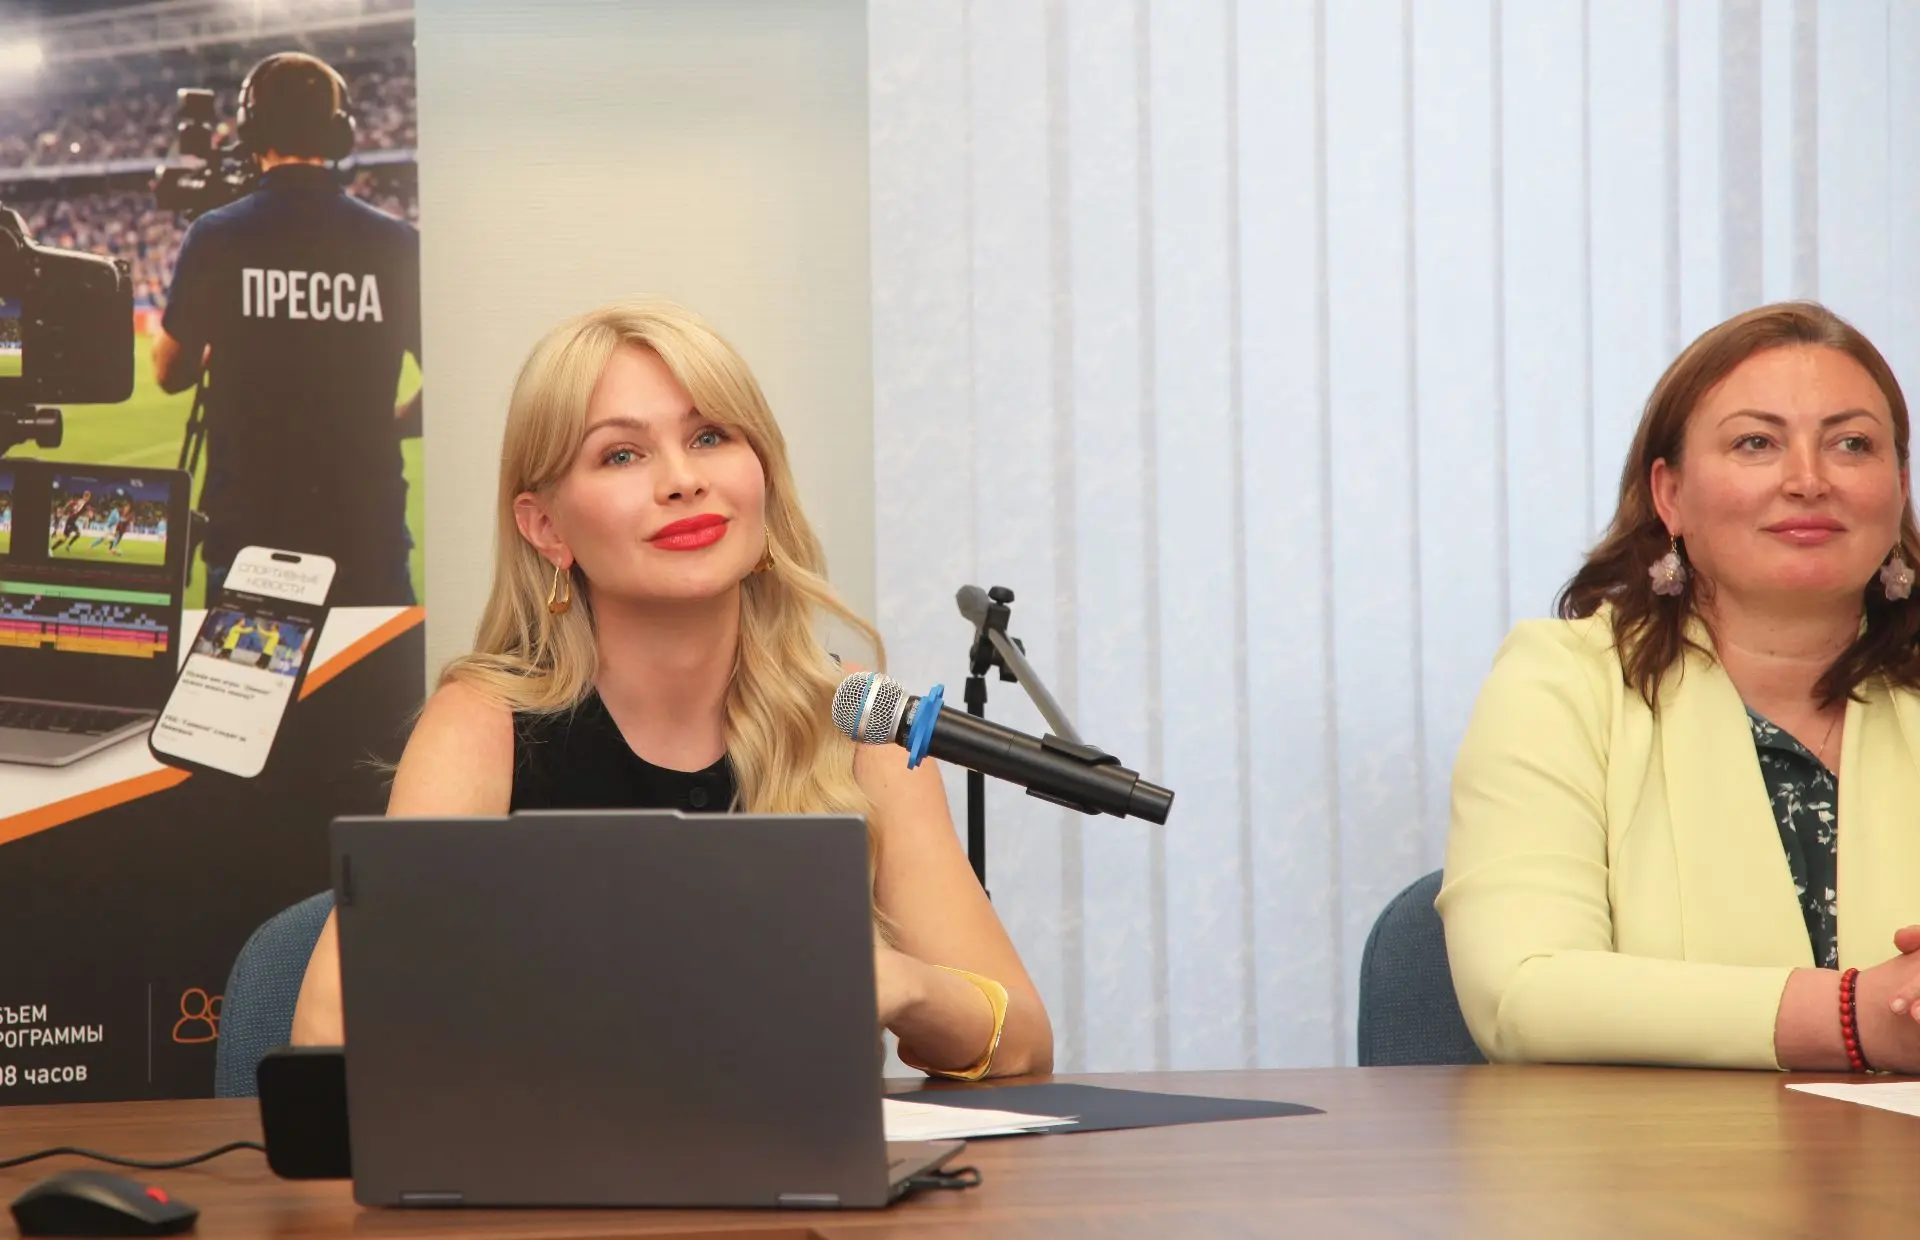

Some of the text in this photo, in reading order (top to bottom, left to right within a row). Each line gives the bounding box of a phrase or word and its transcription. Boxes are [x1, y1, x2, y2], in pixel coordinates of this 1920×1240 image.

[242, 268, 383, 322] ПРЕССА
[0, 1065, 88, 1087] 8 часов
